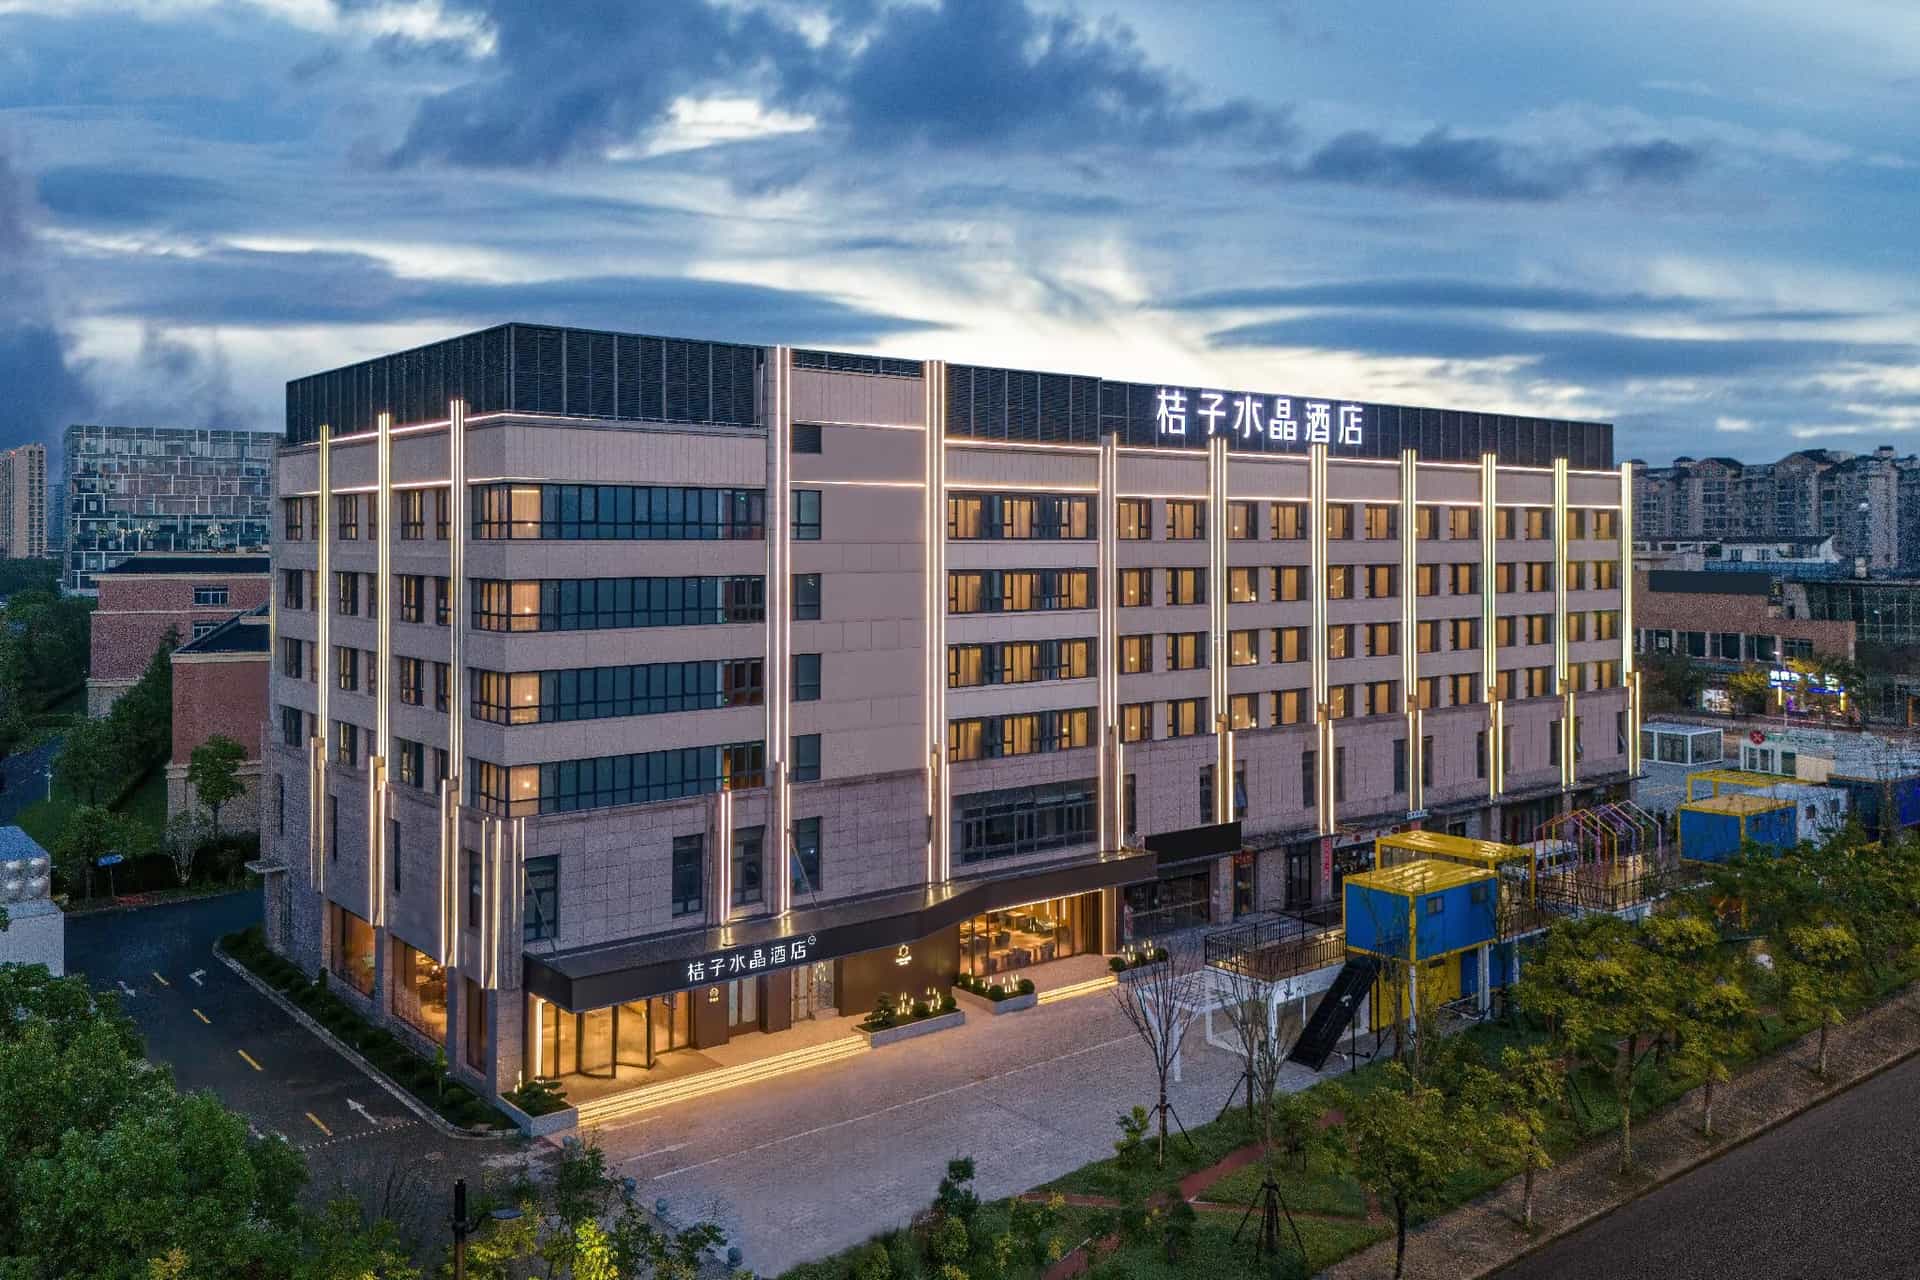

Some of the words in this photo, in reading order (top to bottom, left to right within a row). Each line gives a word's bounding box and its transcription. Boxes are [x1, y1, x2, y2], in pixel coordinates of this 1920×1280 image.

[1156, 388, 1363, 445] 桔子水晶酒店
[687, 941, 807, 982] 桔子水晶酒店
